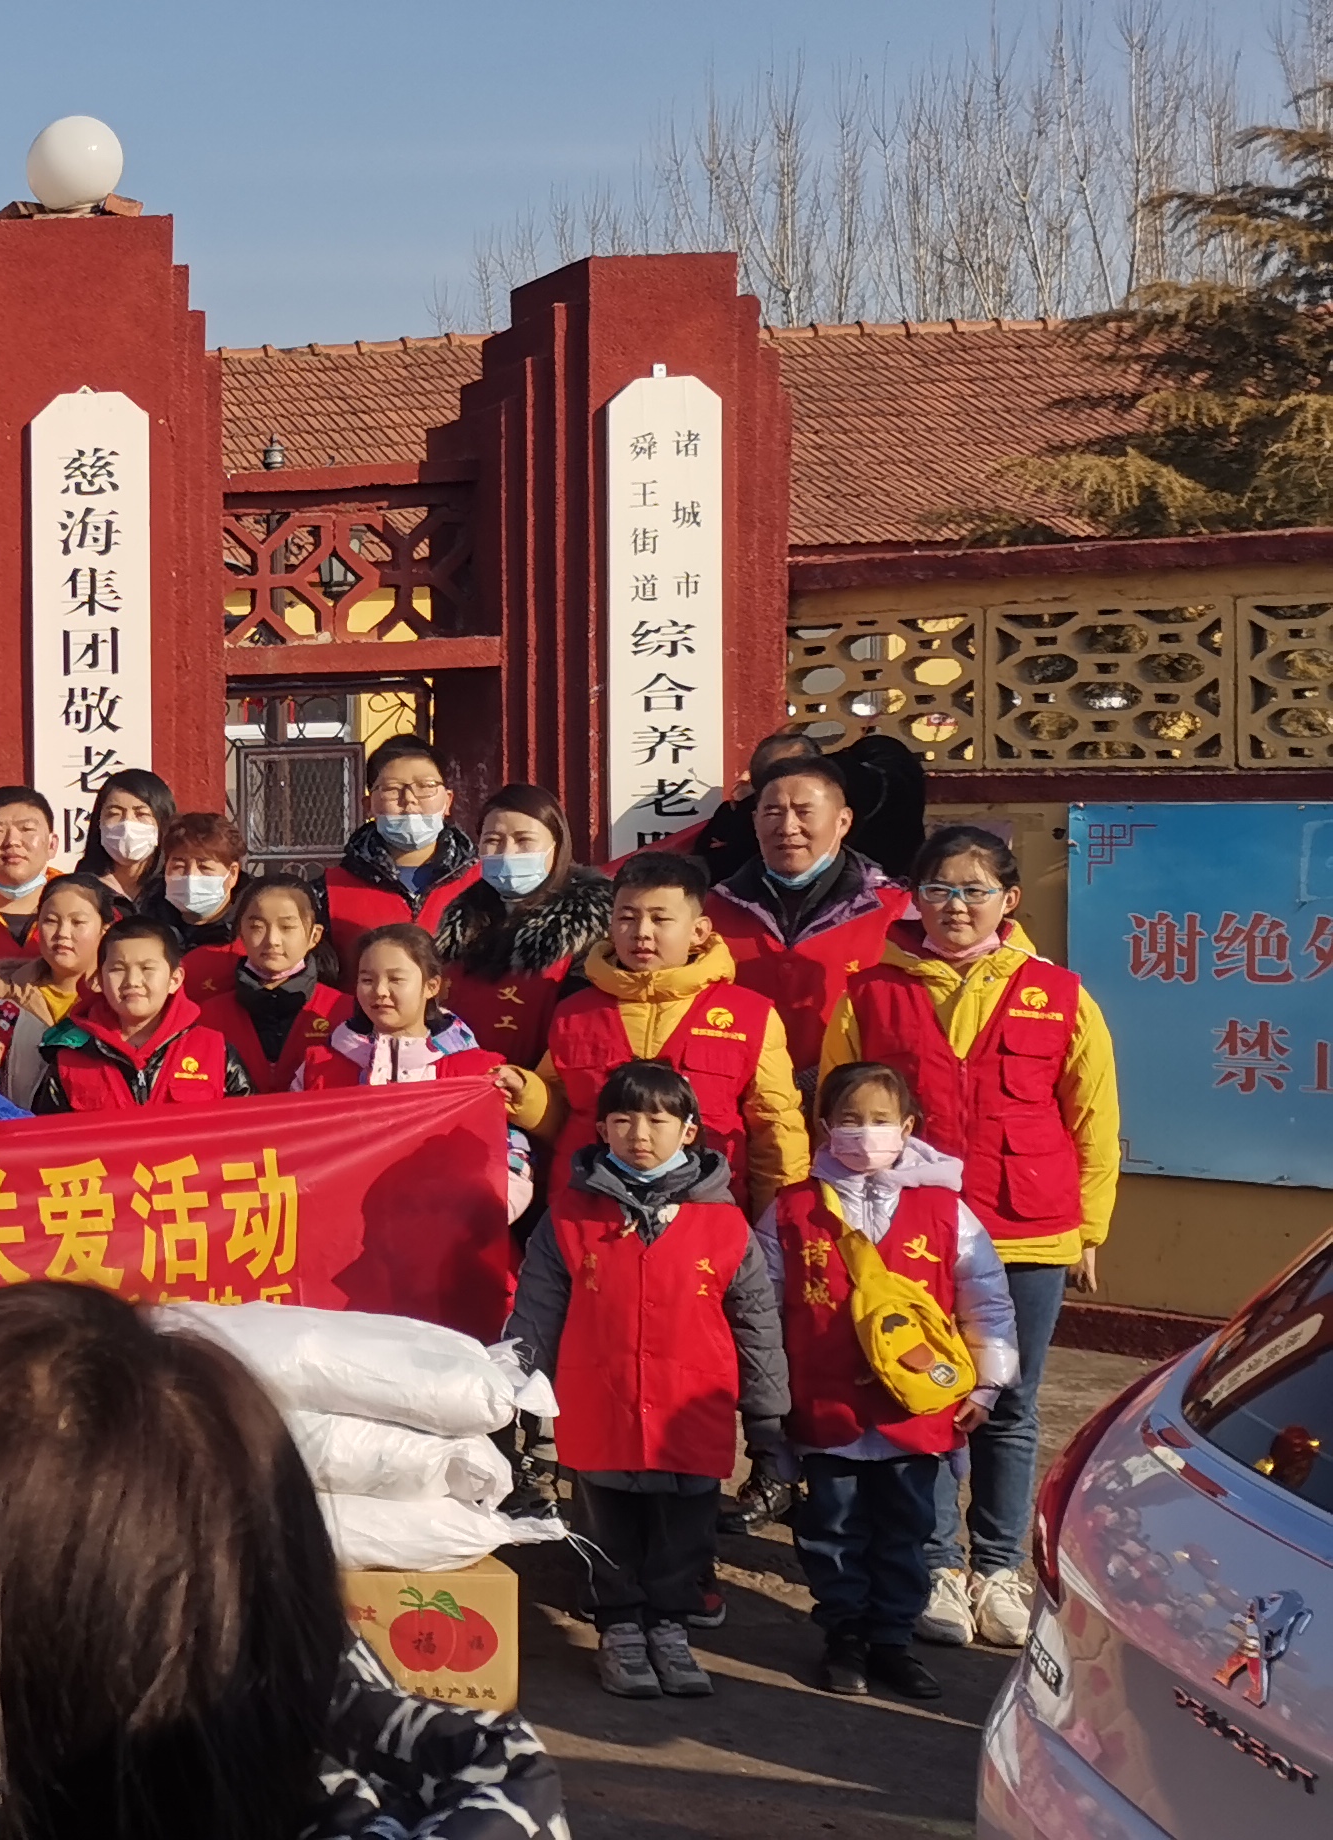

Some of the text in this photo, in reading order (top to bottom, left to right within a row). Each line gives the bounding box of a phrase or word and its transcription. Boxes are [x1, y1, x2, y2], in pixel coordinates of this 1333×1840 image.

[629, 431, 660, 602] 舜王街道
[671, 429, 703, 599] 诸城市
[631, 618, 700, 849] 综合养老
[494, 985, 525, 1031] 义工
